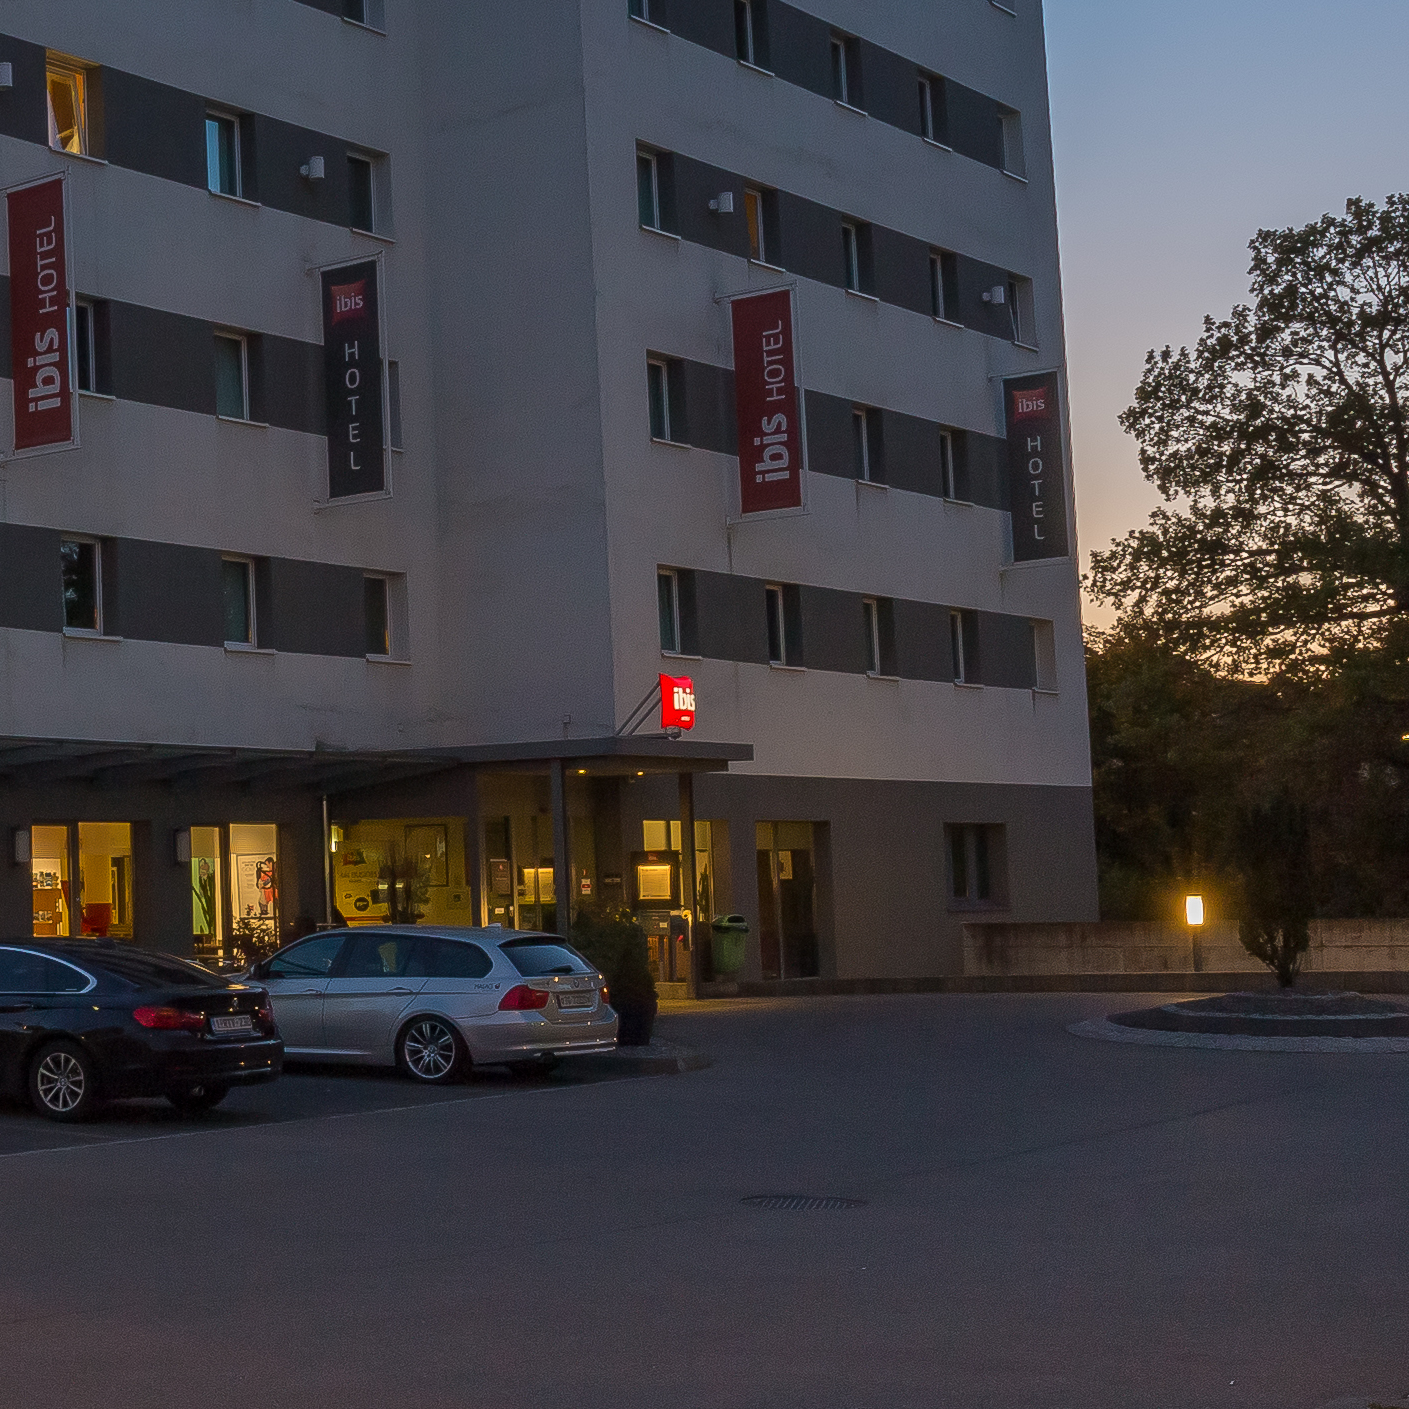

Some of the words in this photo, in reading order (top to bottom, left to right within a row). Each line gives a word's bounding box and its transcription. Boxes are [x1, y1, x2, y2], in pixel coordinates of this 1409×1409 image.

[36, 215, 58, 314] HOTEL
[336, 292, 364, 313] ibis
[27, 327, 61, 413] ibis
[762, 319, 786, 401] HOTEL
[344, 341, 361, 470] HOTEL
[1018, 397, 1045, 413] ibis
[753, 412, 790, 483] ibis
[1026, 435, 1045, 540] HOTEL
[673, 686, 696, 711] ibis
